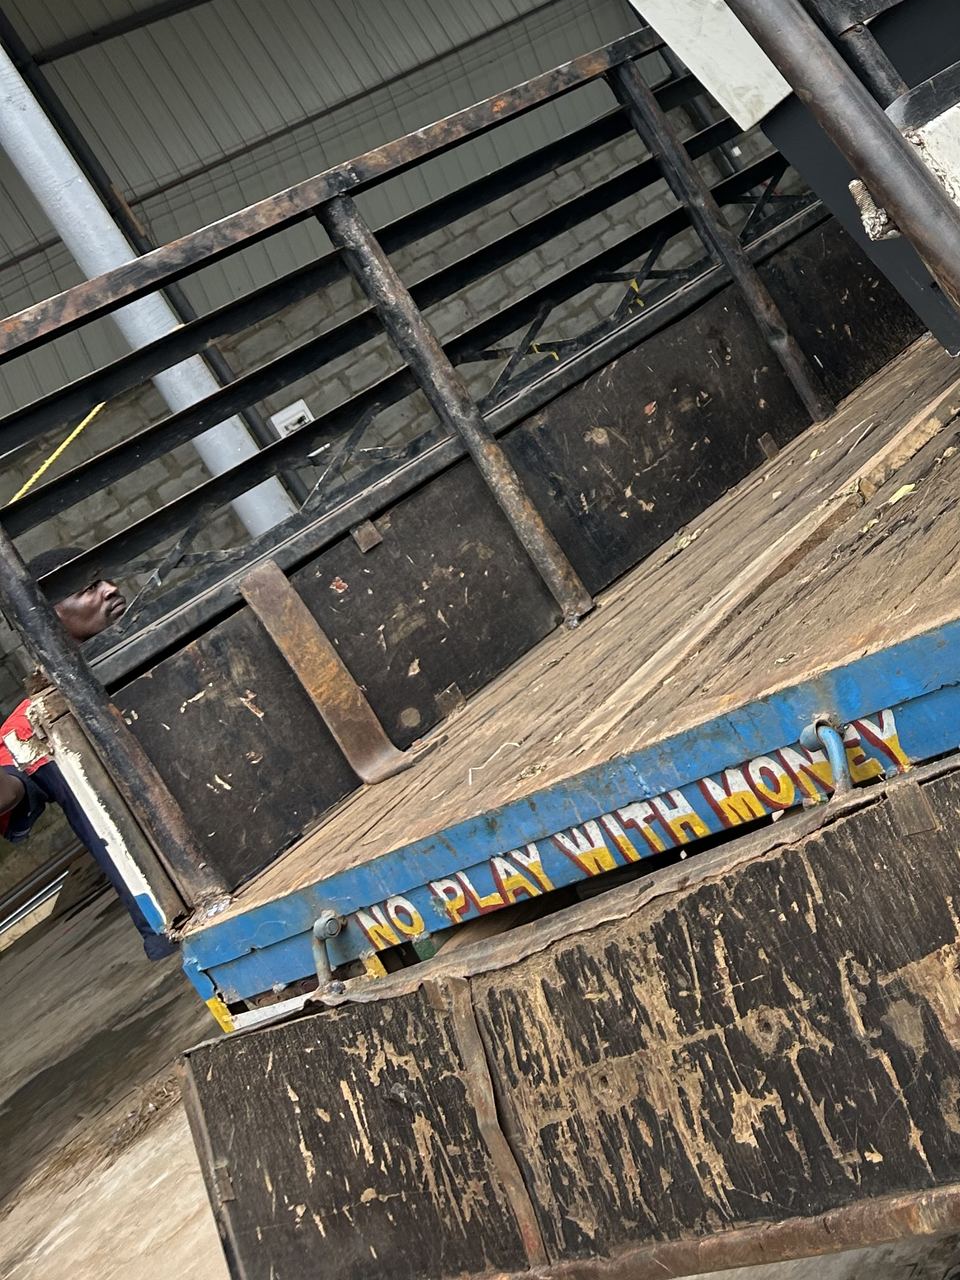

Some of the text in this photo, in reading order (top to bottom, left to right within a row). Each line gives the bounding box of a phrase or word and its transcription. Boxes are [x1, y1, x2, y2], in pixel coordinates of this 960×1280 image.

[356, 708, 910, 951] NO PLAY WITH MONEY
